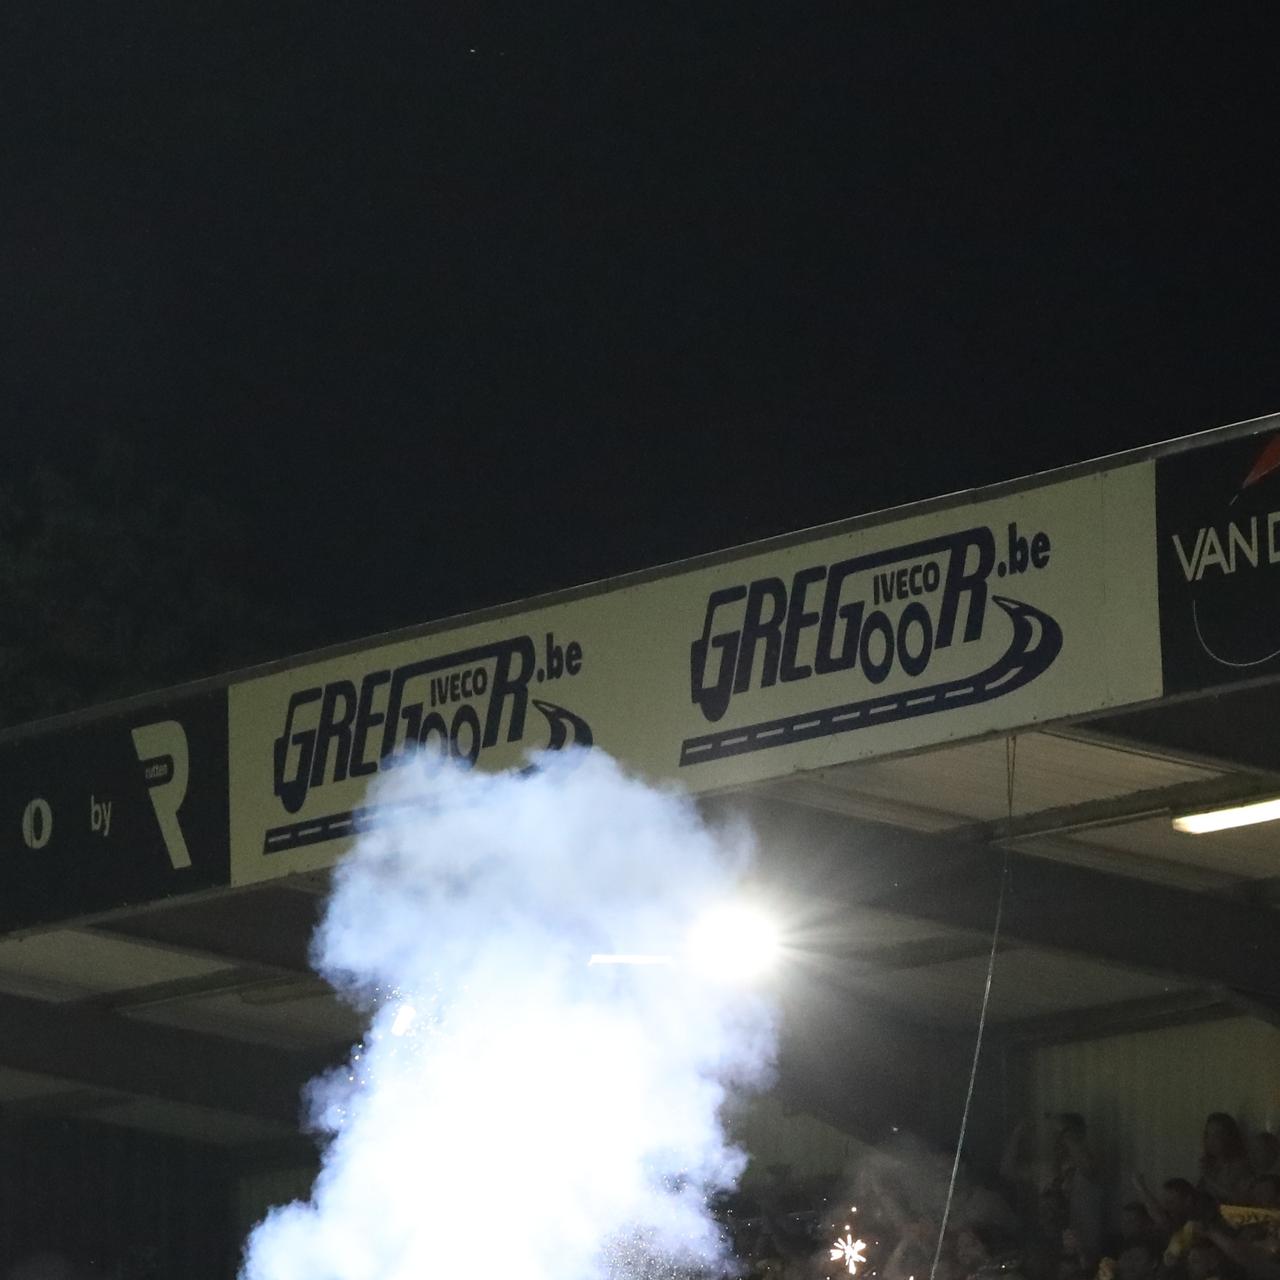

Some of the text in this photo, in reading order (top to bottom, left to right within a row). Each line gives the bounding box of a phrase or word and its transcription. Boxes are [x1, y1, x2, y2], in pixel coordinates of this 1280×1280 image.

[872, 561, 941, 606] IVECO
[430, 666, 488, 707] IVECO
[90, 795, 113, 837] by
